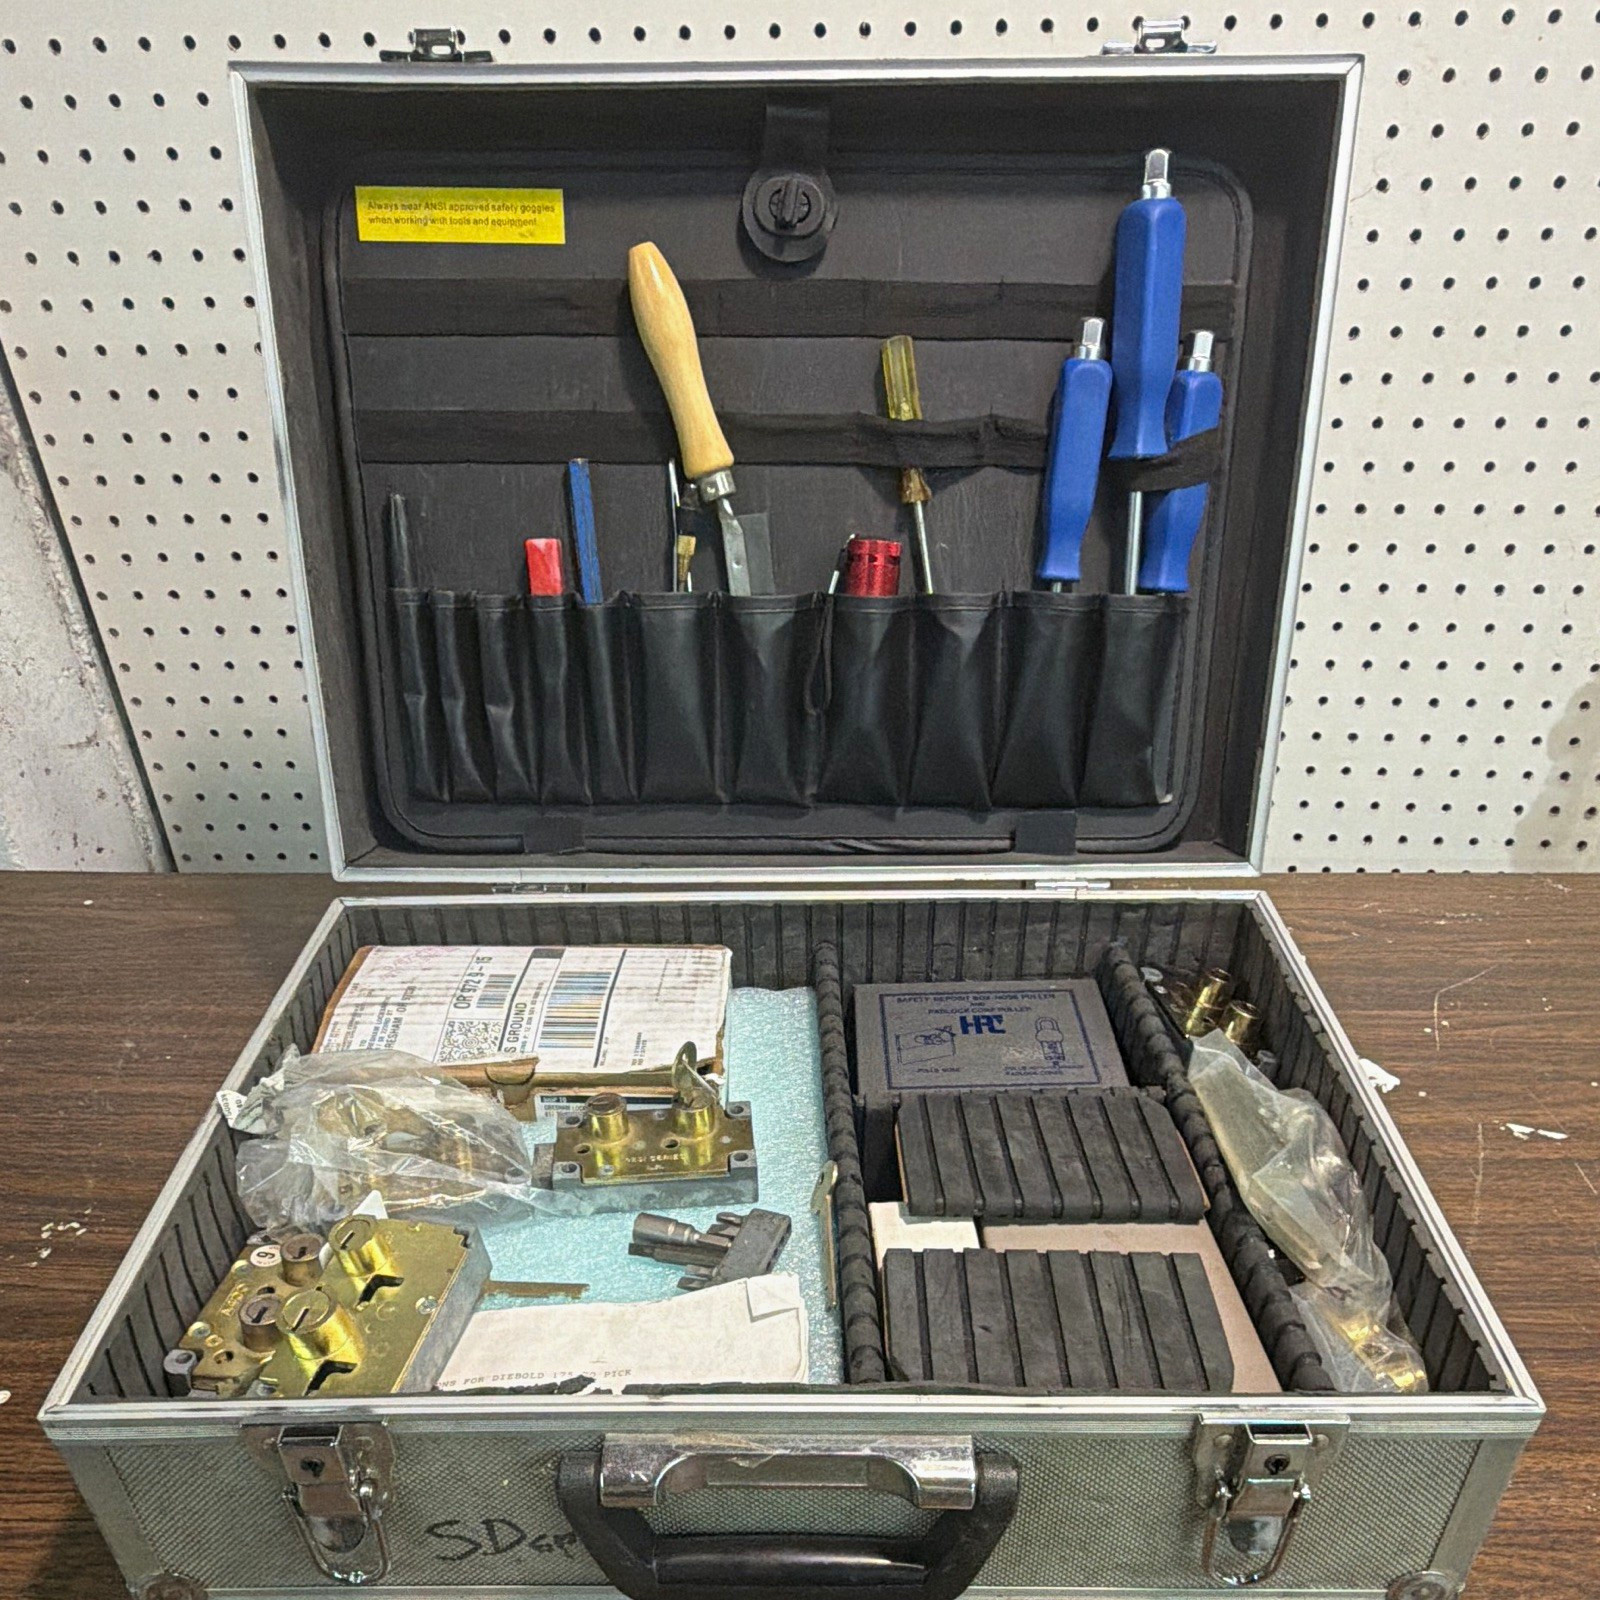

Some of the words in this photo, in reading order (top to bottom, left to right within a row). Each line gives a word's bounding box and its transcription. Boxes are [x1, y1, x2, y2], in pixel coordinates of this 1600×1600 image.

[368, 201, 399, 211] Always
[424, 202, 447, 210] ANSI
[449, 203, 490, 212] approved
[491, 203, 518, 213] safety
[520, 204, 555, 214] goggles
[368, 216, 392, 224] when
[394, 216, 428, 226] working
[449, 217, 471, 225] tools
[473, 217, 489, 225] and
[491, 218, 537, 227] equipment
[453, 991, 475, 1010] OR
[934, 994, 970, 1002] DEPOSIT
[507, 1002, 527, 1043] GROUND
[384, 1017, 403, 1049] RESHAM
[463, 1376, 485, 1384] FOR
[492, 1372, 545, 1382] DIEBOLD
[604, 1369, 632, 1378] PICK
